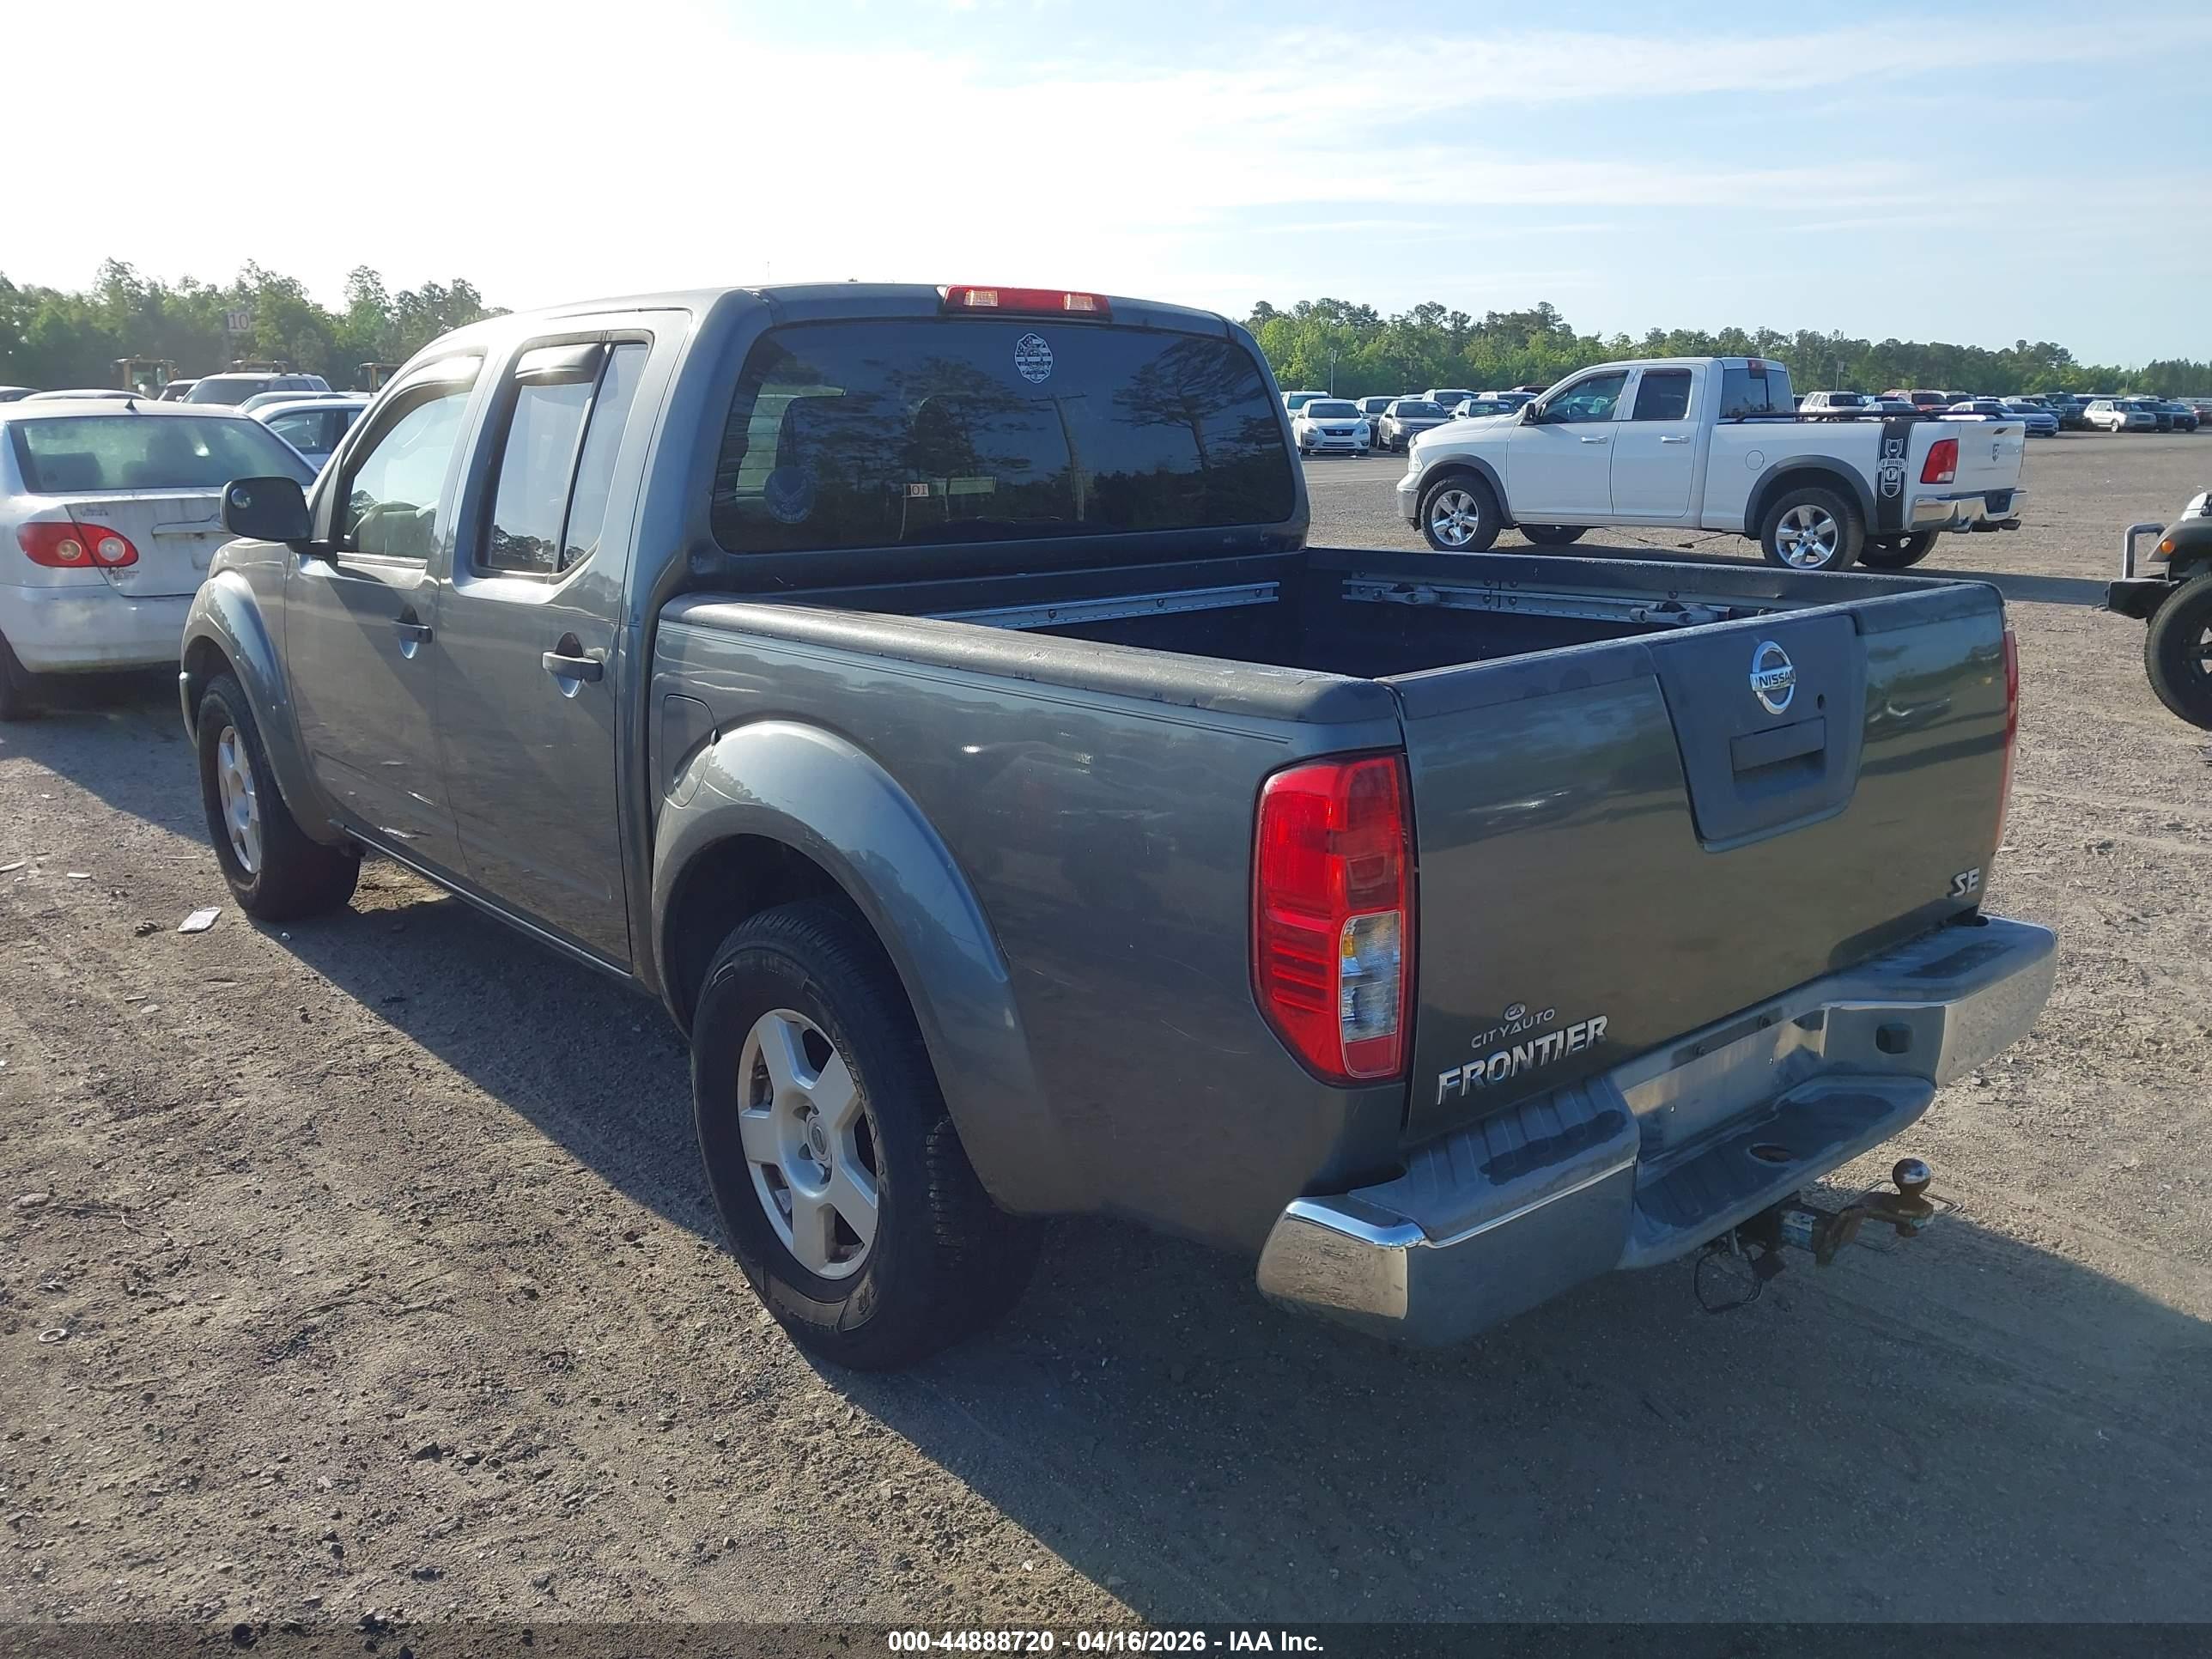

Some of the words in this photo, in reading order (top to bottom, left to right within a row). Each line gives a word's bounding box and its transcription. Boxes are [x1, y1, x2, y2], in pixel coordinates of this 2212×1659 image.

[229, 314, 249, 331] 10
[1952, 867, 1980, 897] SE
[1436, 1015, 1608, 1105] FRONTIER
